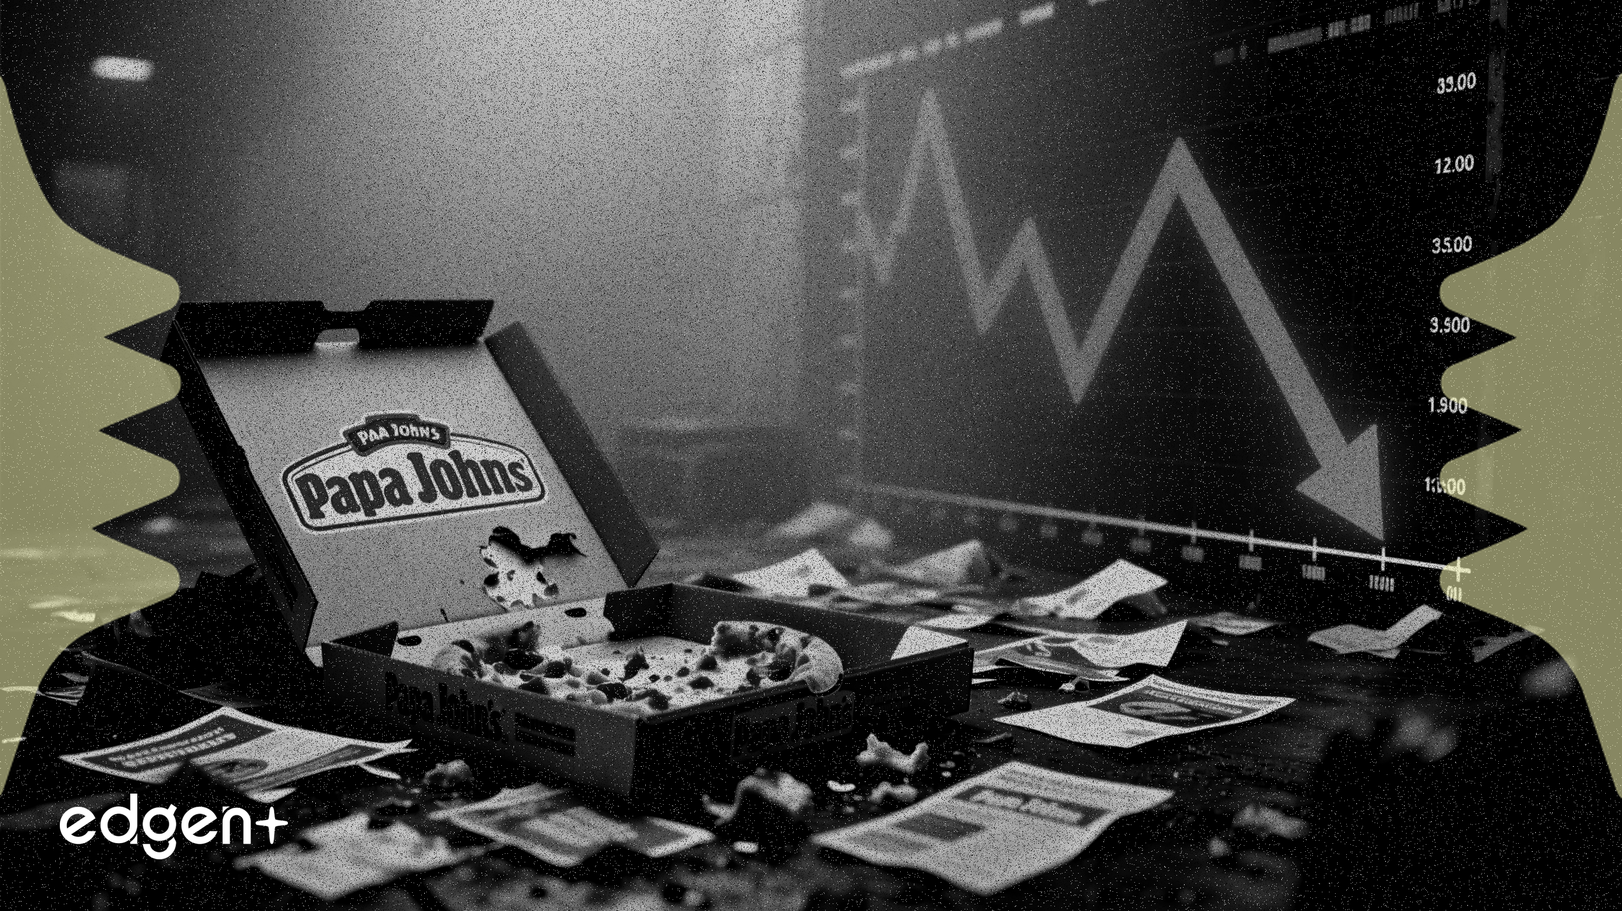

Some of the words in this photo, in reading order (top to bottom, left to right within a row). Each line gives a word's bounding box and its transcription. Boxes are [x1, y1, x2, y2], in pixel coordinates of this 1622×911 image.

[1434, 154, 1475, 174] 12.00
[295, 467, 414, 519] Papa
[406, 449, 534, 504] Johns
